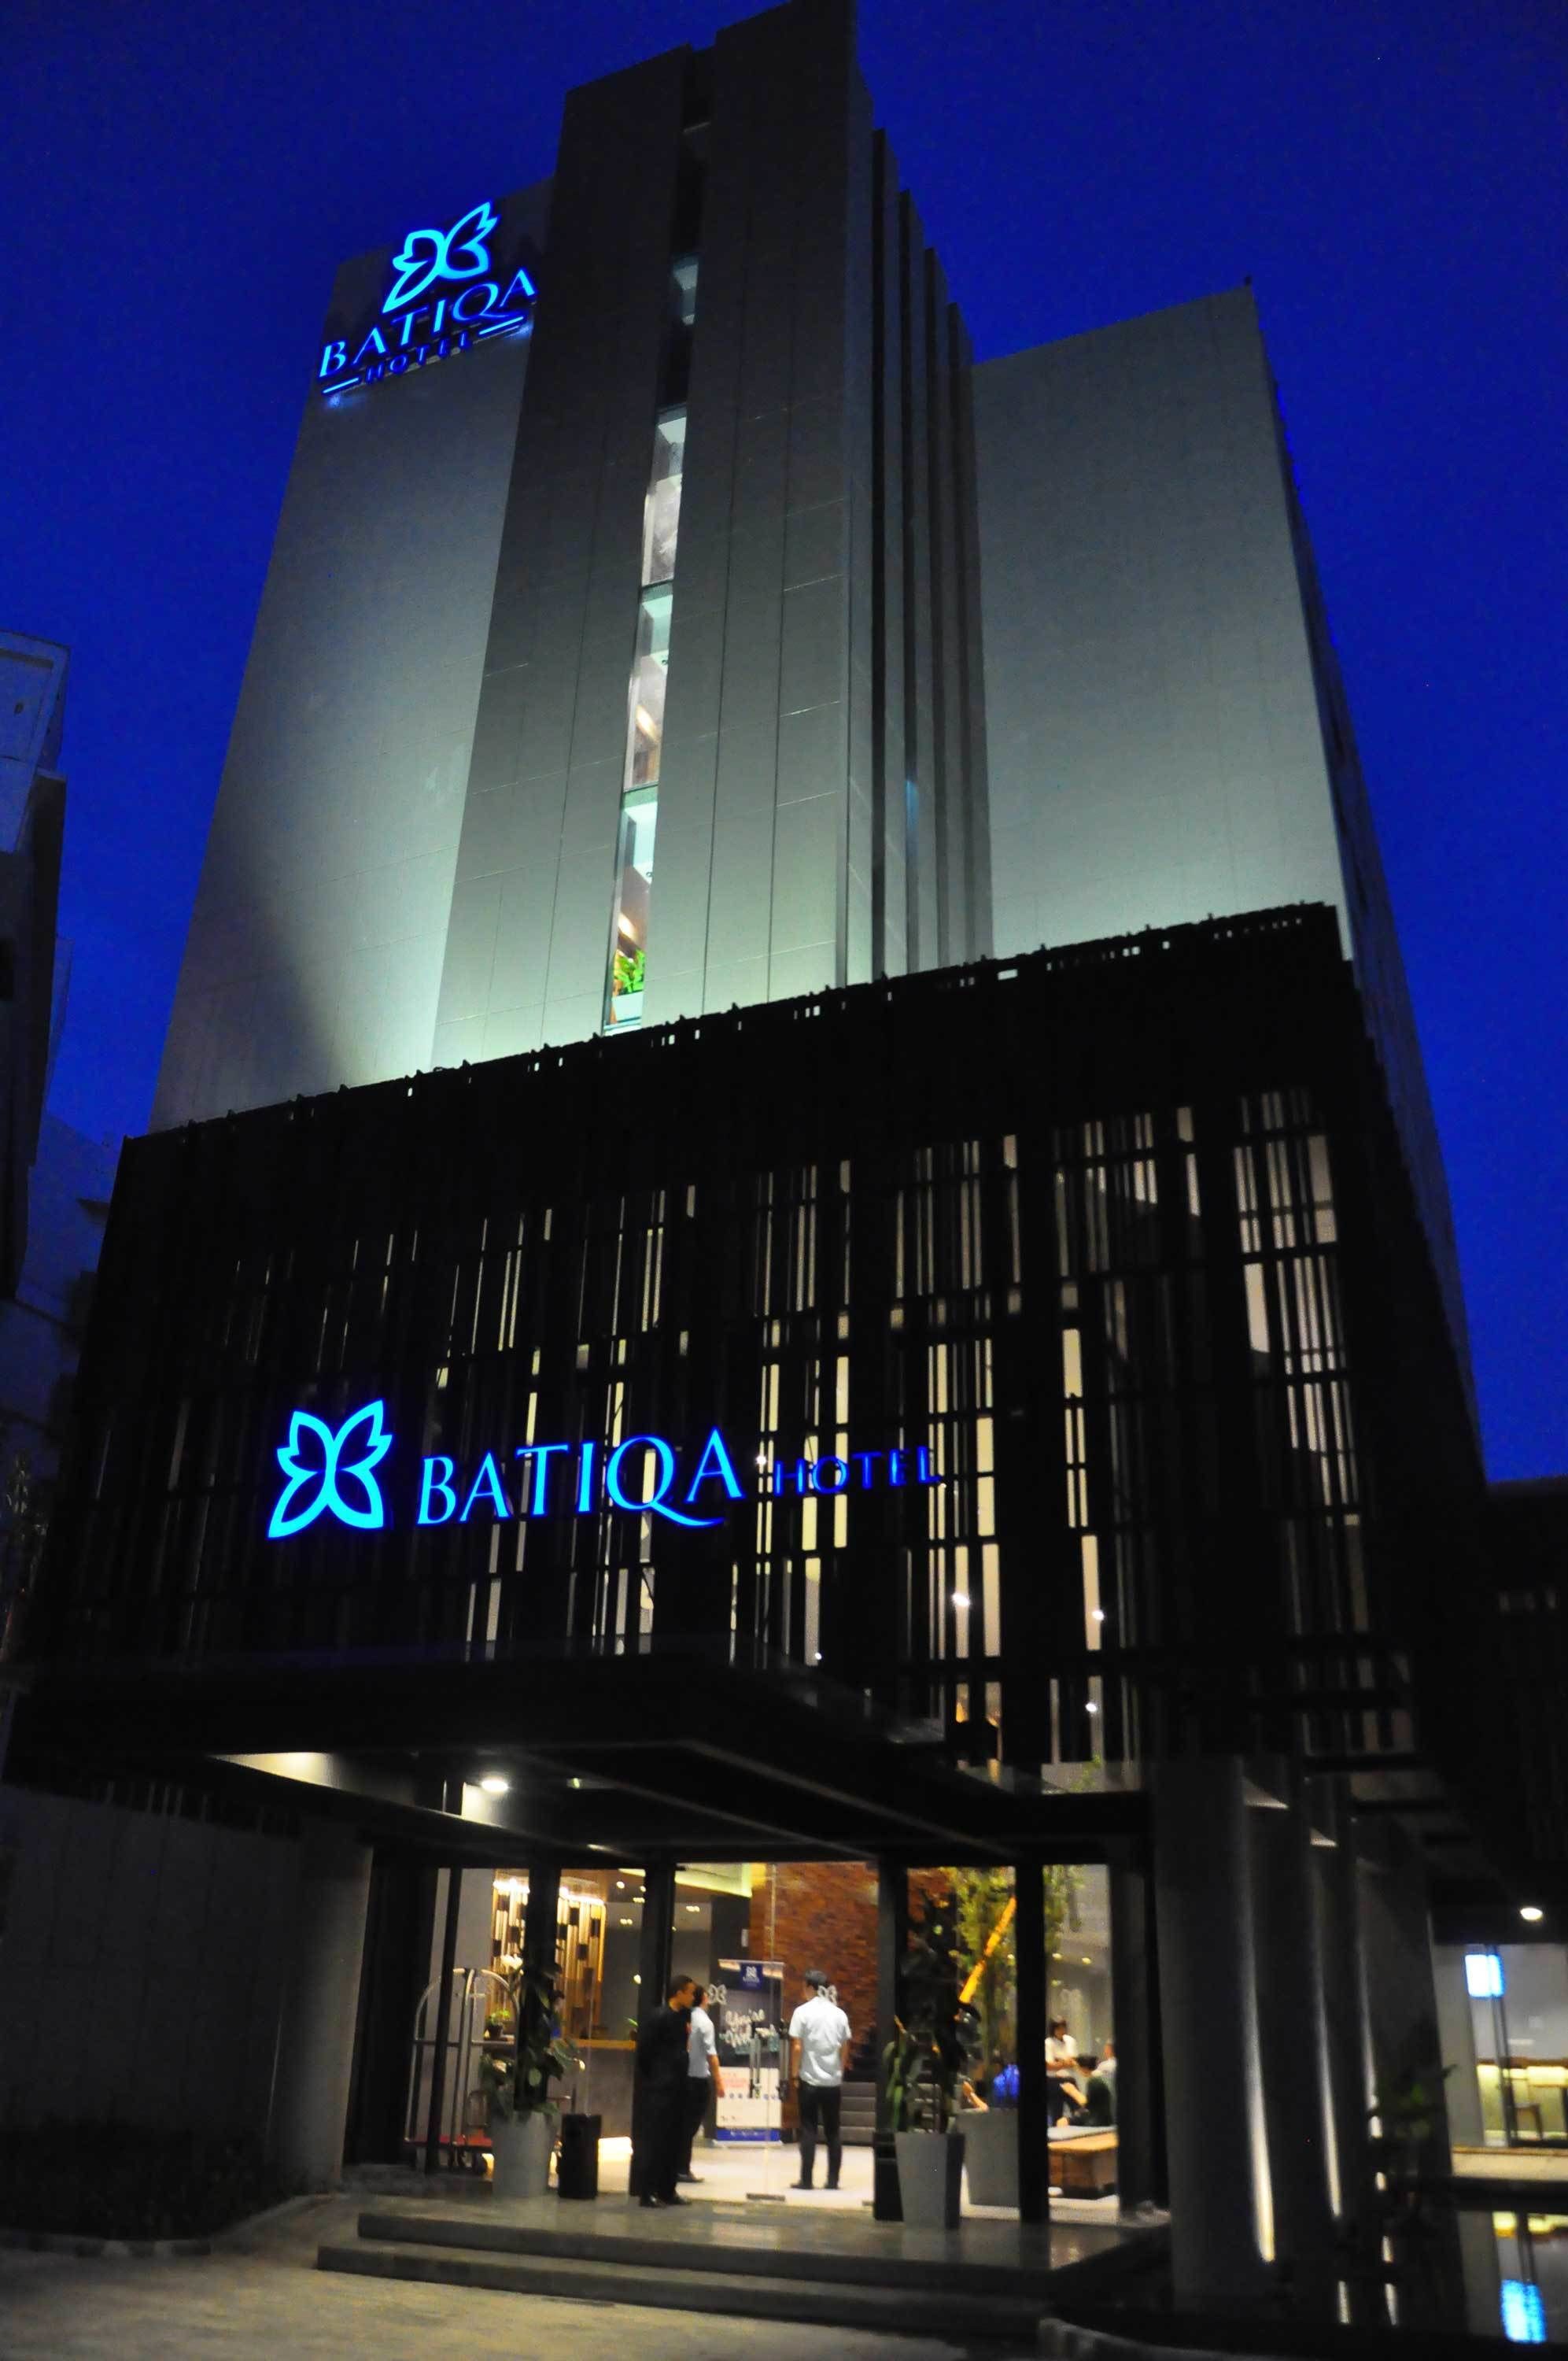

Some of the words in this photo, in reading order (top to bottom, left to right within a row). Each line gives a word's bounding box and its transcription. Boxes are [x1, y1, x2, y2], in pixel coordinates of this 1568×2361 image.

[318, 268, 537, 378] BATIQA
[416, 1428, 743, 1527] BATIQA
[774, 1446, 941, 1495] HOTEL
